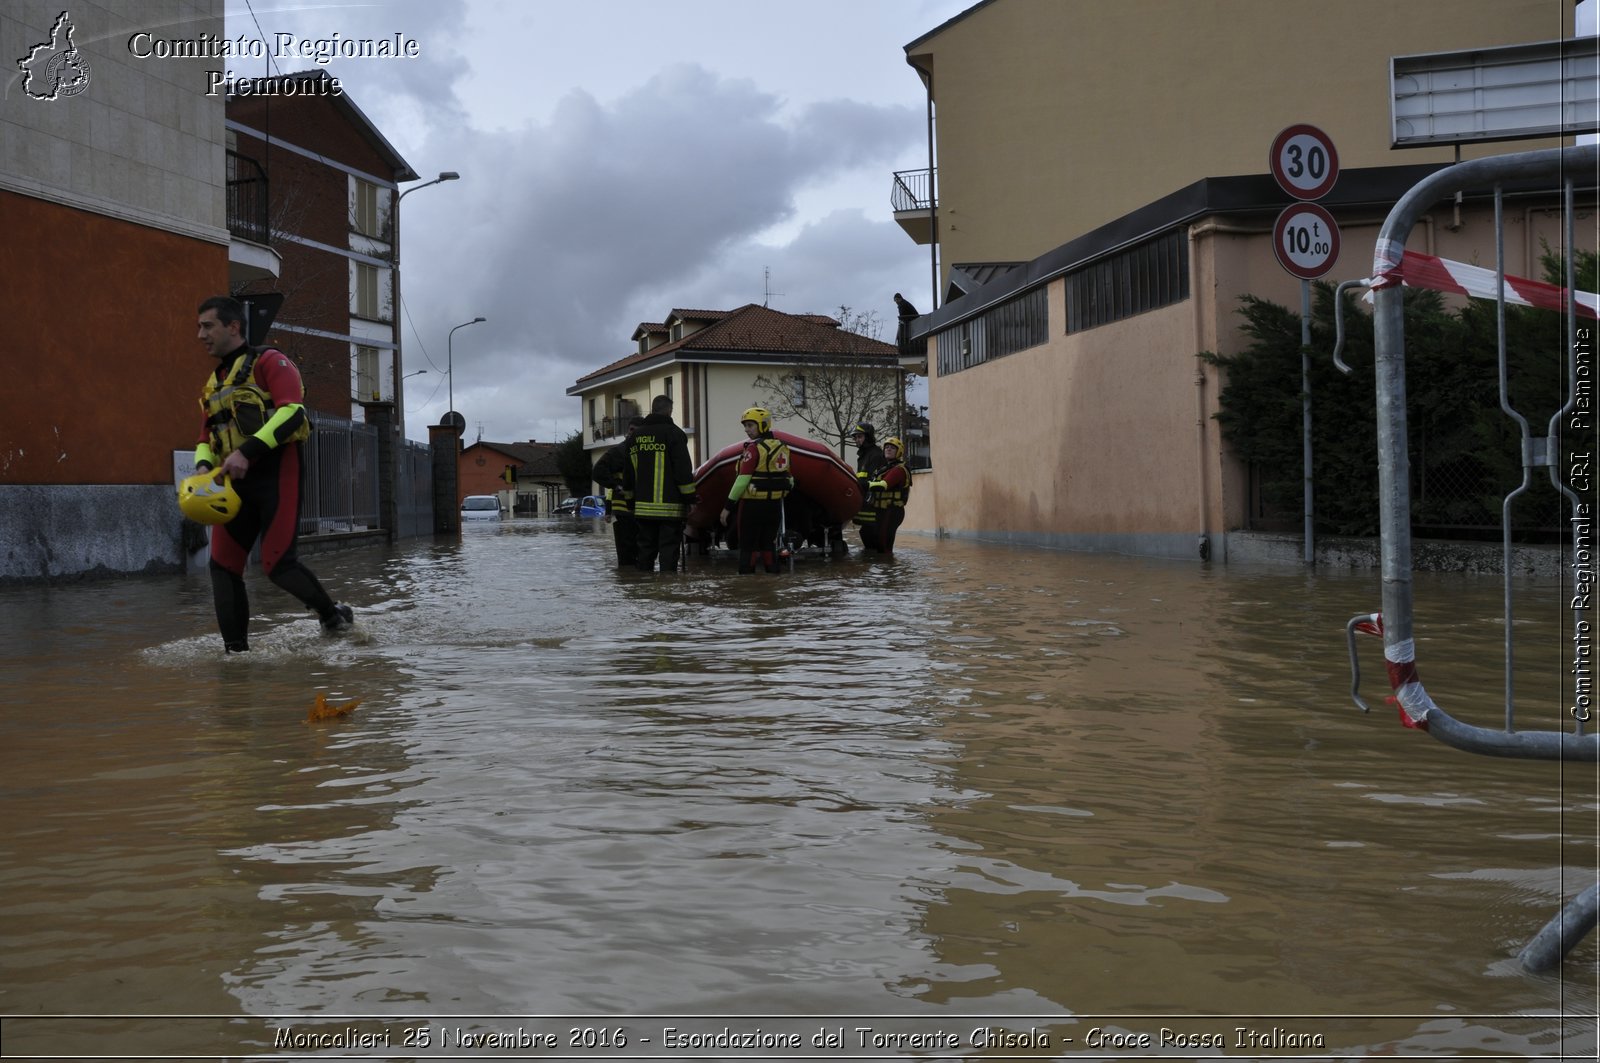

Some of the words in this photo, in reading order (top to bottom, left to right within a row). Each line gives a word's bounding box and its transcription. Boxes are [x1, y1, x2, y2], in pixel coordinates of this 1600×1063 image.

[1287, 144, 1325, 180] 30
[636, 435, 656, 443] VIGILI
[640, 443, 666, 451] FUOCO
